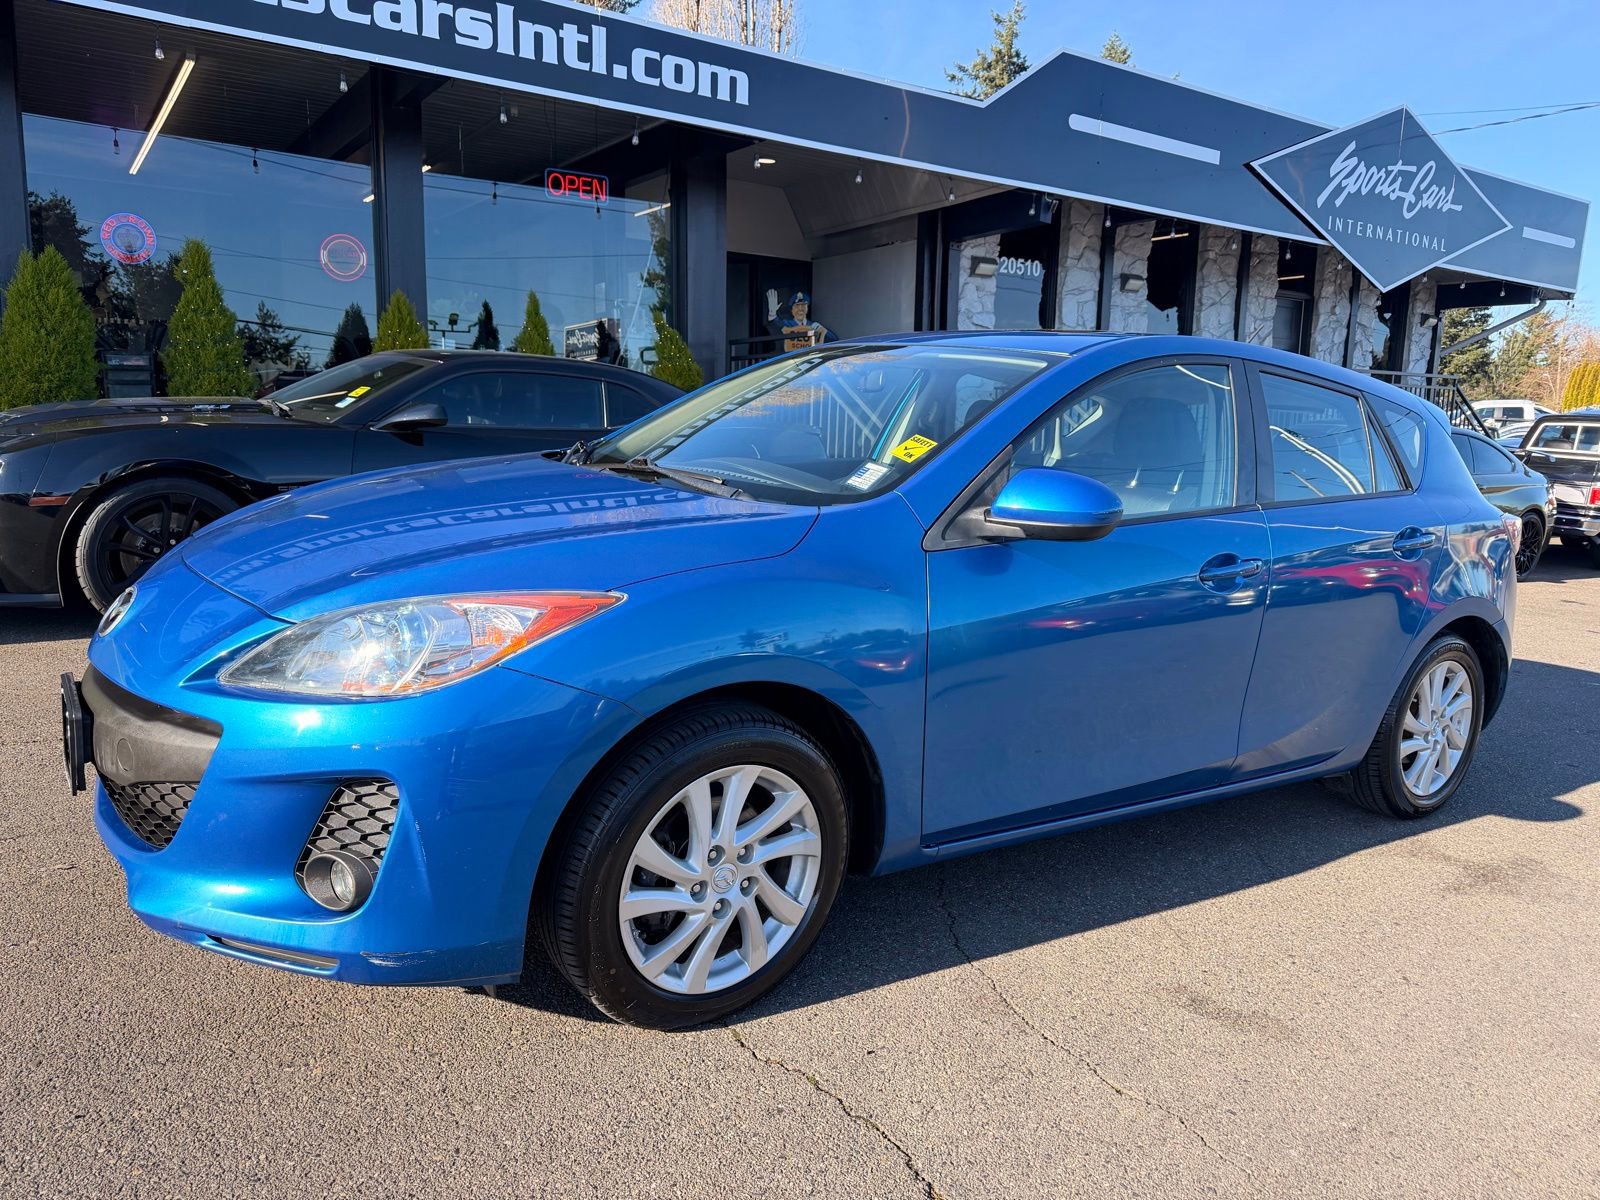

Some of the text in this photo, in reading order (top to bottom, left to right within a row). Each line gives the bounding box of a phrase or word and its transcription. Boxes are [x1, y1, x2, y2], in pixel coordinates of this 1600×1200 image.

[252, 0, 750, 106] arsIntl.com
[548, 172, 607, 202] OPEN
[101, 218, 116, 240] RED
[1328, 215, 1446, 252] INTERNATIONAL
[999, 256, 1041, 277] 20510
[910, 436, 934, 449] SAFETY
